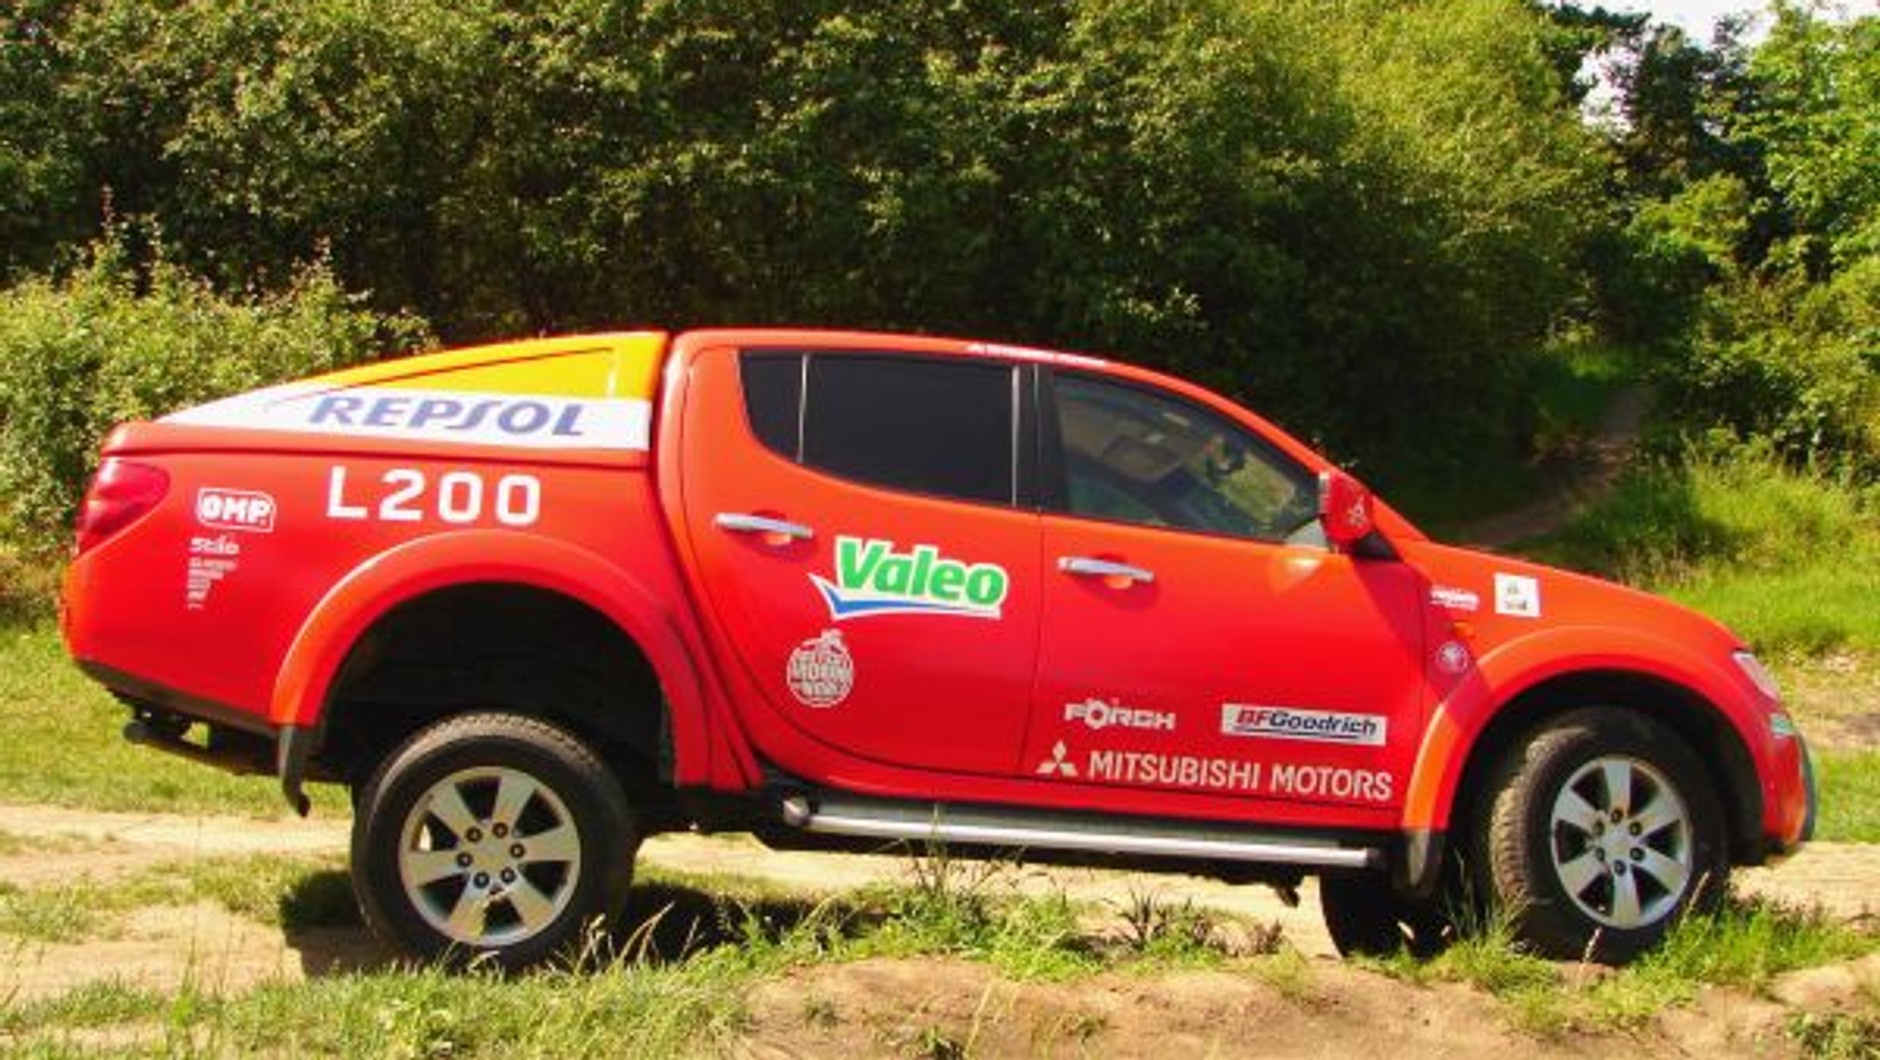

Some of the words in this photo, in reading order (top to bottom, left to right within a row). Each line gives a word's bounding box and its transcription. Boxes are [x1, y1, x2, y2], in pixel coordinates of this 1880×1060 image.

[308, 395, 584, 436] REPSOL
[326, 465, 541, 525] L200
[838, 538, 1005, 606] Valeo
[1236, 708, 1377, 736] BFGoodrich
[1087, 749, 1262, 790] MITSUBISHI
[1269, 762, 1393, 801] MOTORS
